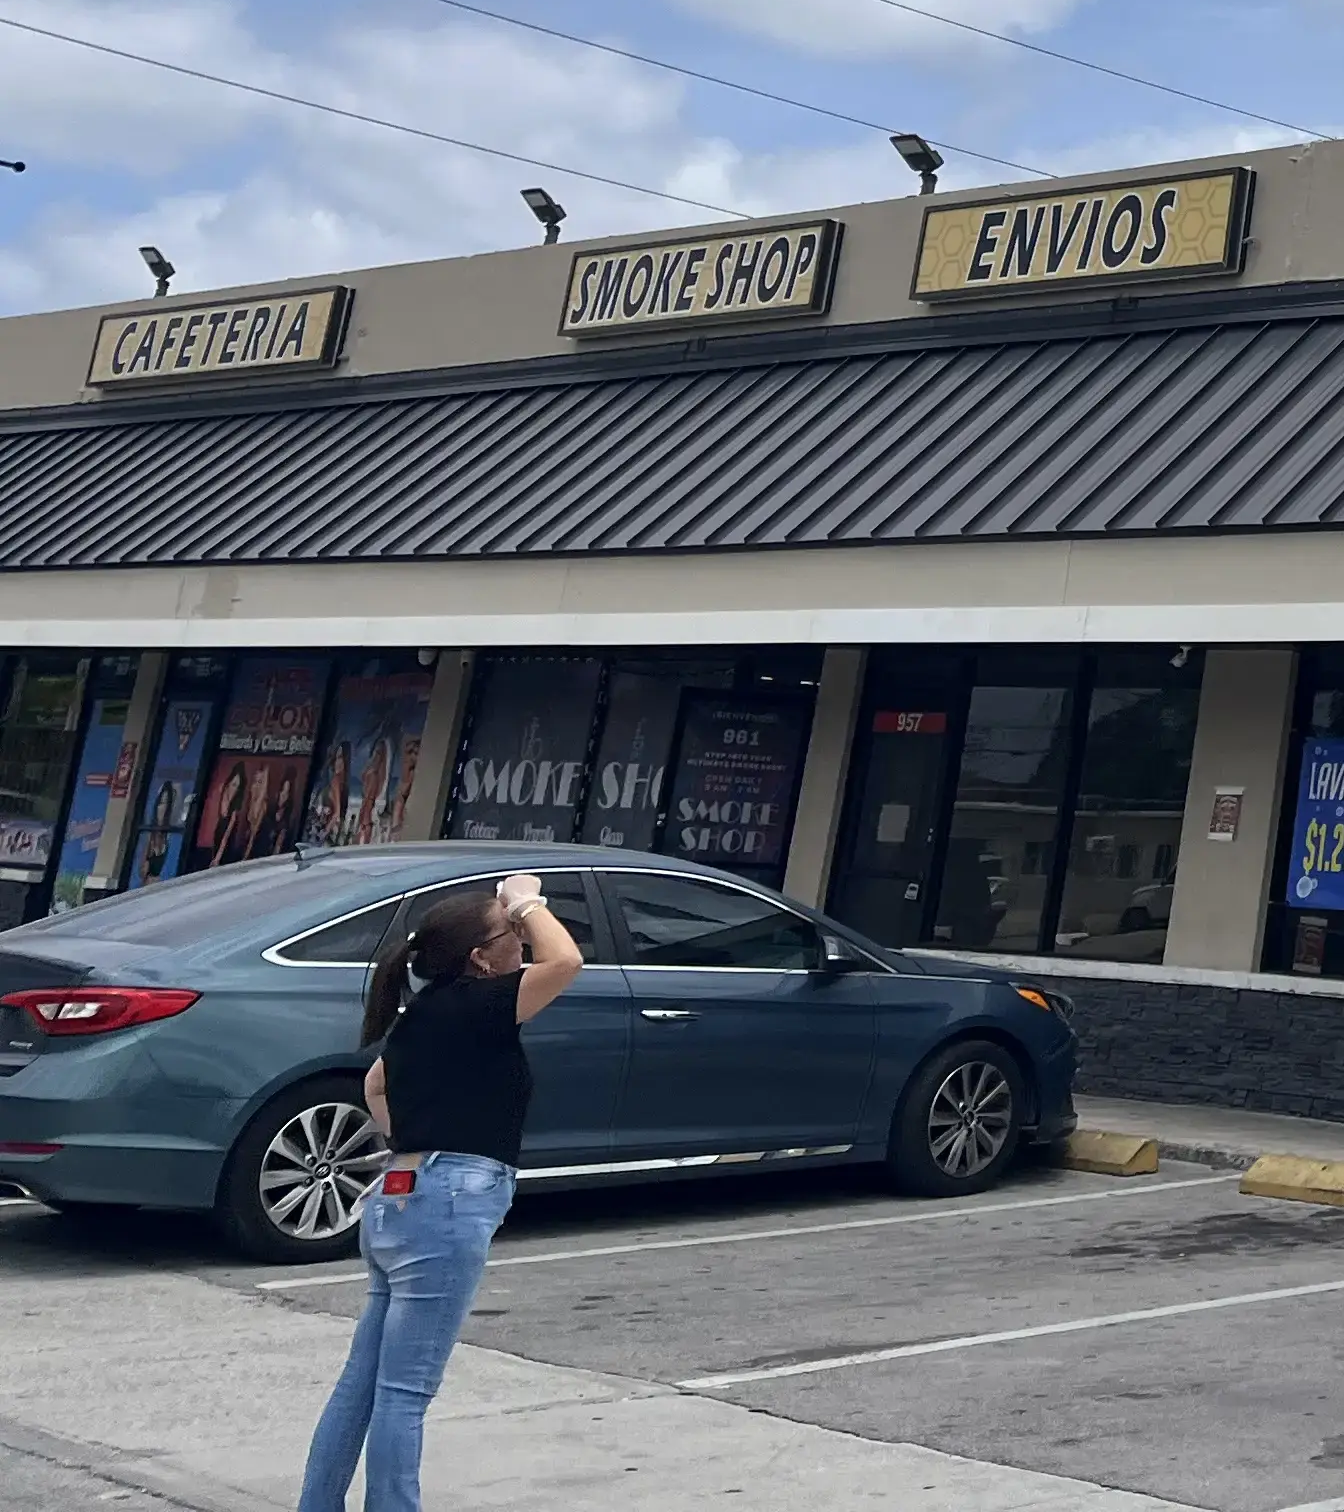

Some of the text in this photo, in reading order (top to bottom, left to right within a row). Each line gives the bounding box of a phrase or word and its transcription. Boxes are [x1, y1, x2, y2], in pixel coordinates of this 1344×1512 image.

[965, 188, 1177, 283] ENVIOS
[569, 232, 818, 325] SMOKE SHOP
[111, 300, 311, 376] CAFETERIA
[896, 711, 924, 732] 957
[459, 758, 583, 806] SMOKE
[676, 797, 780, 826] SMOKE
[678, 826, 766, 853] SHOP
